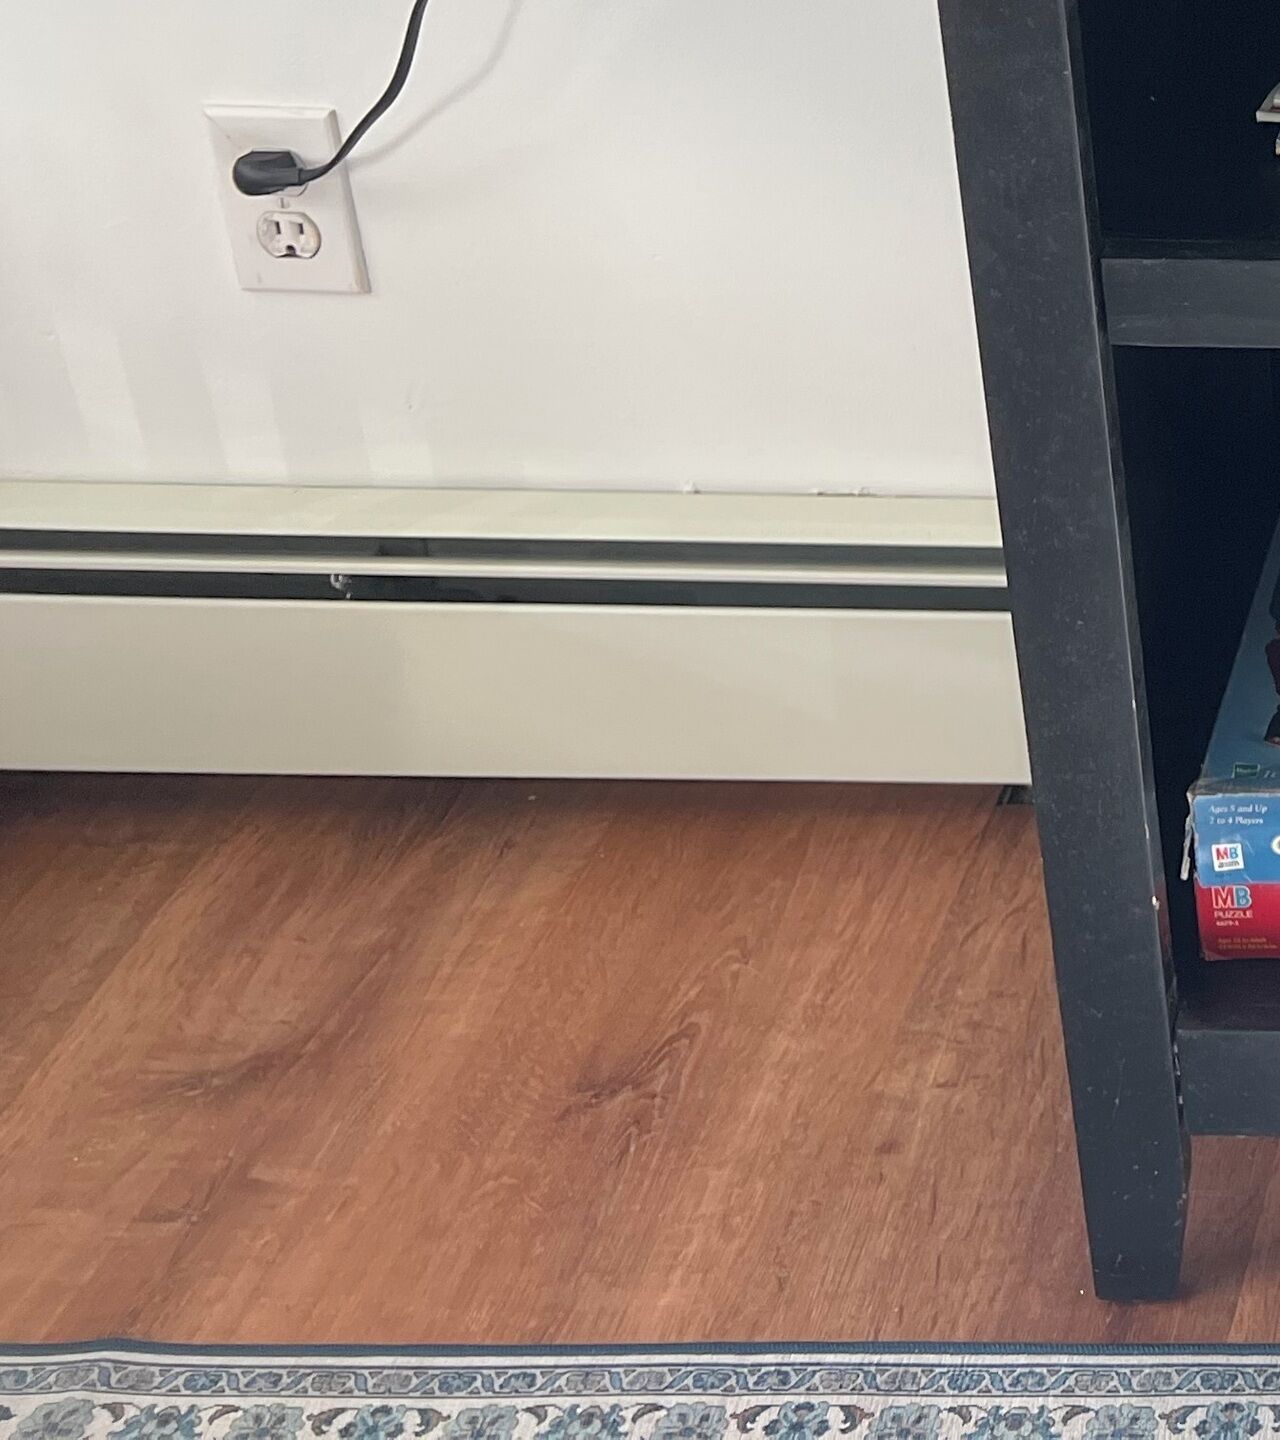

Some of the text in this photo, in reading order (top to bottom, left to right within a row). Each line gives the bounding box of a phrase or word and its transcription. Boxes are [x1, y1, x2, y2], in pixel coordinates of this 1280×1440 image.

[1237, 805, 1253, 813] and
[1255, 805, 1268, 815] Up
[1235, 816, 1264, 826] Players
[1215, 847, 1239, 861] MB
[1211, 885, 1253, 909] MB
[1214, 910, 1253, 919] PUZZLE
